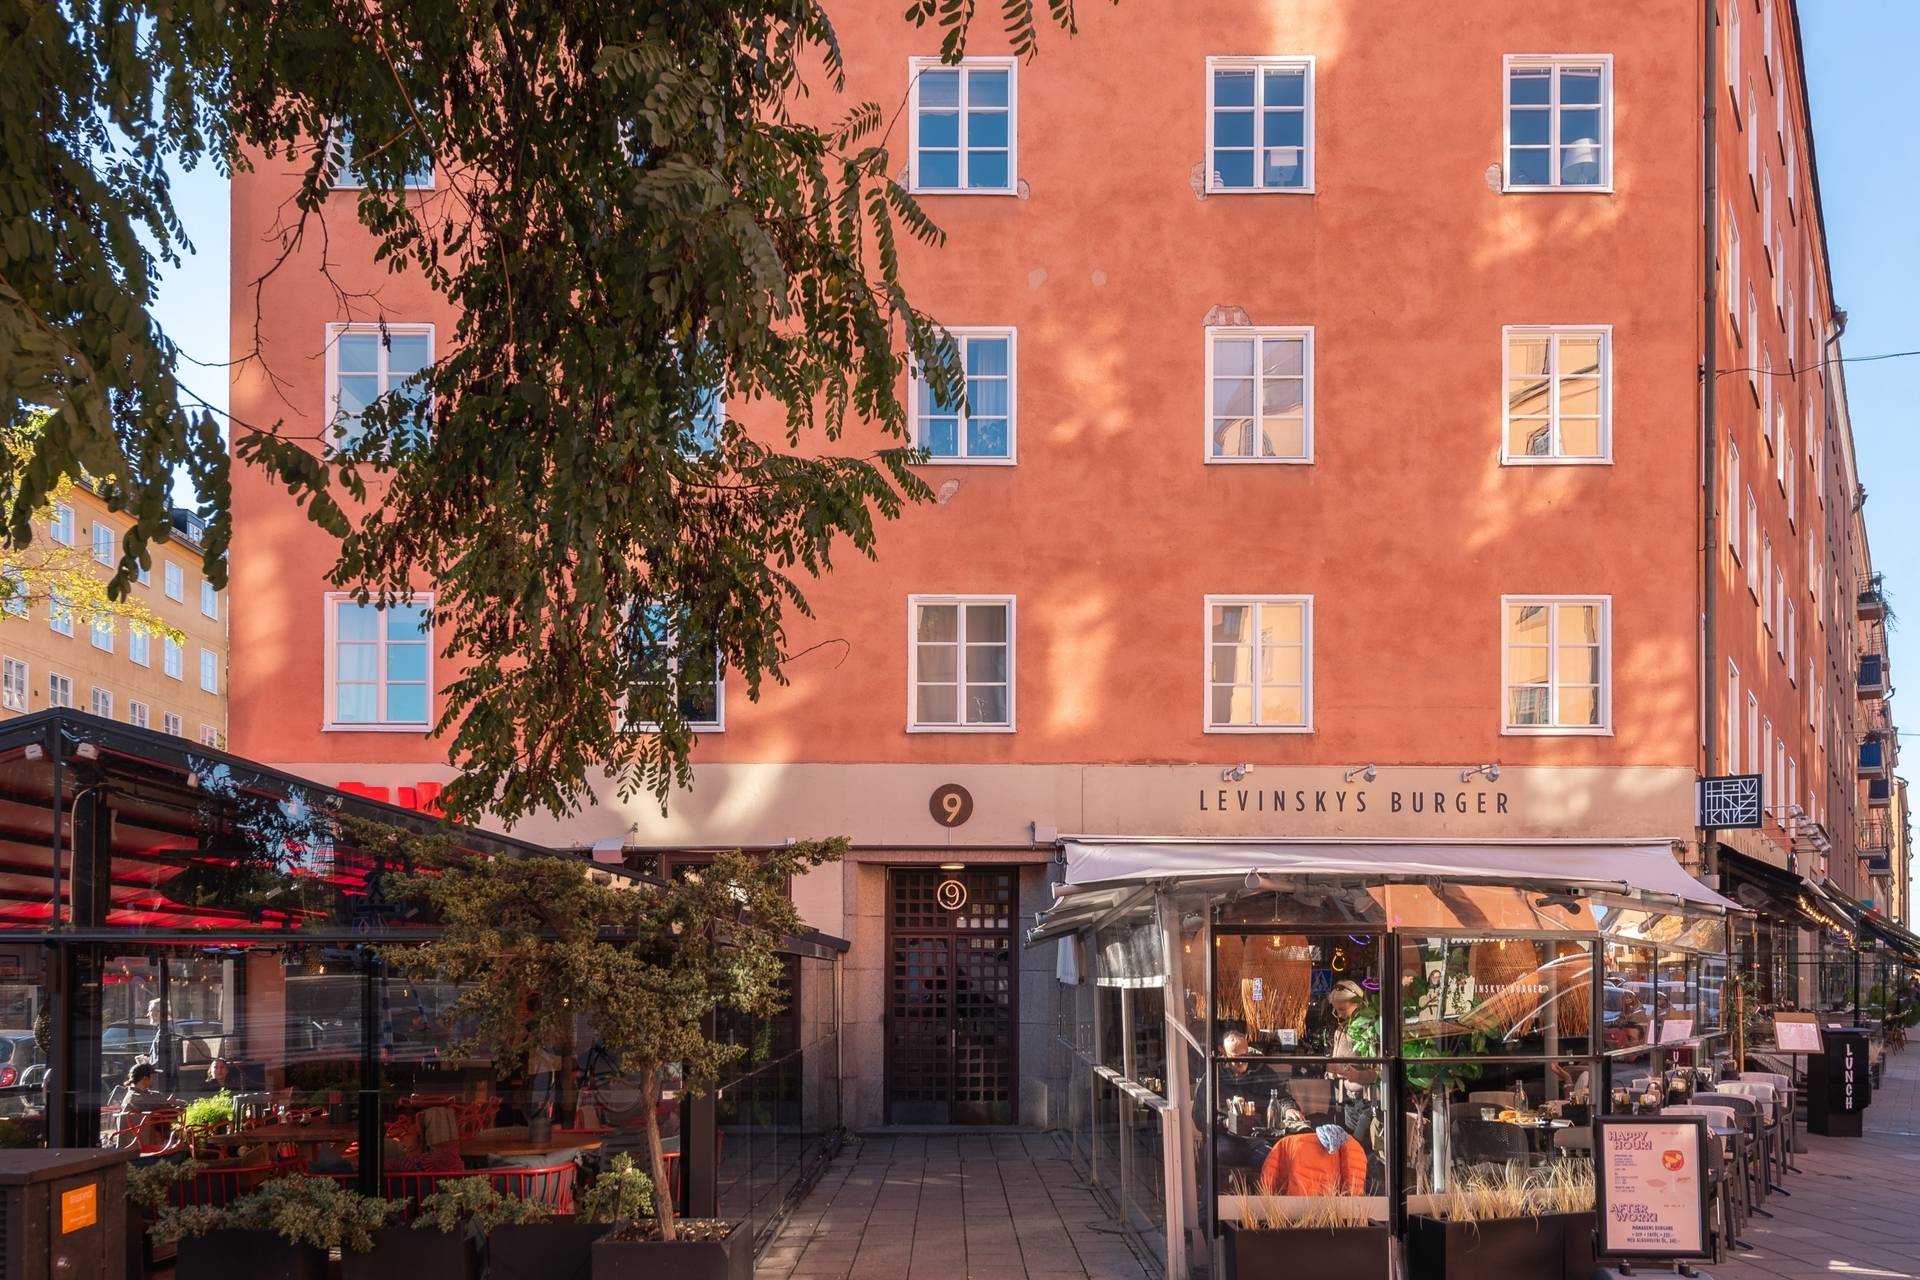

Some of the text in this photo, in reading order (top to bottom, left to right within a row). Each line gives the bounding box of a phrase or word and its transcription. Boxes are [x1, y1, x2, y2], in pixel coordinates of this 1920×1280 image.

[942, 793, 962, 823] 9
[1199, 790, 1509, 814] LEVINSKYS BURGER
[945, 884, 960, 906] 9
[1845, 1043, 1853, 1109] LUNCH
[1609, 1131, 1648, 1141] HAPPY
[1610, 1204, 1648, 1213] AFTER
